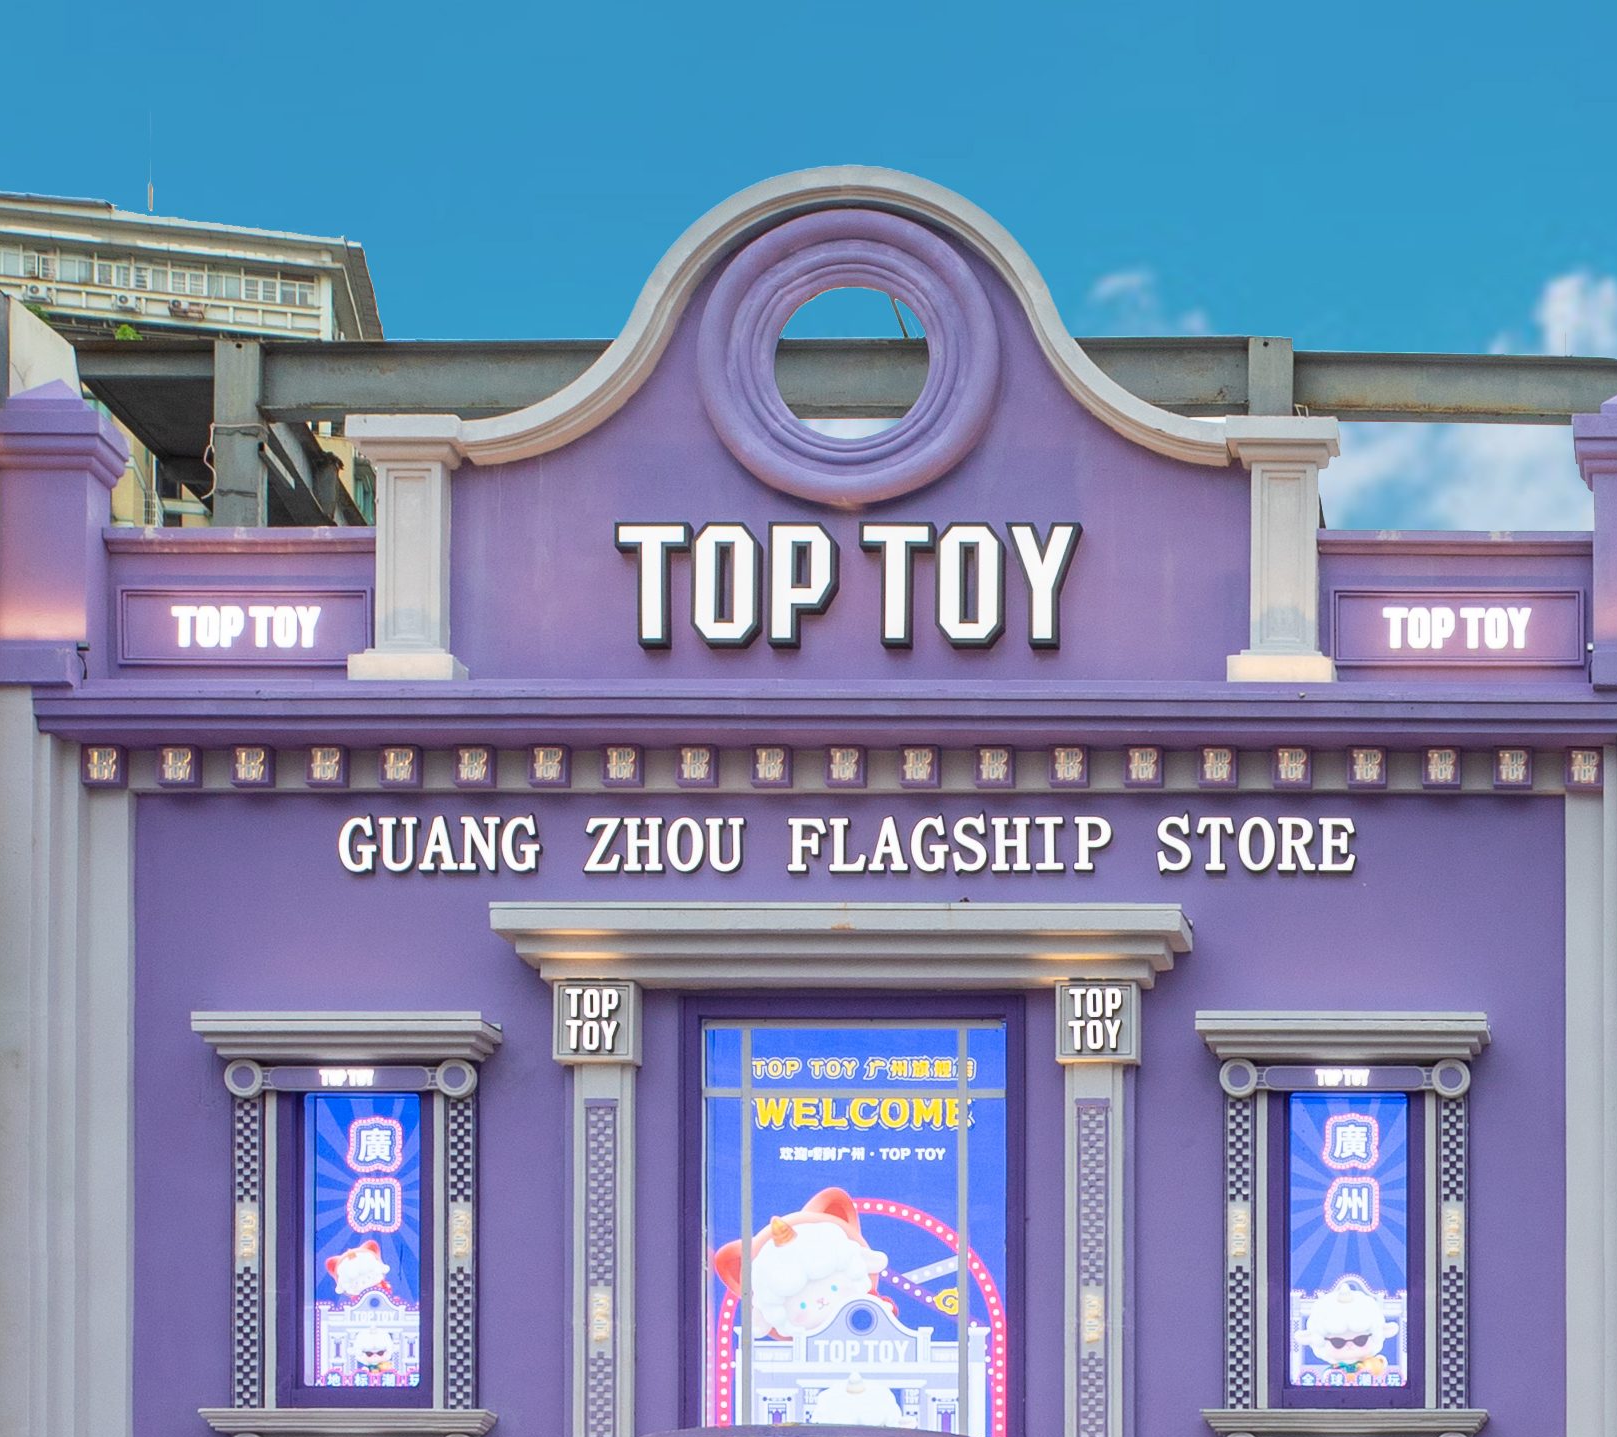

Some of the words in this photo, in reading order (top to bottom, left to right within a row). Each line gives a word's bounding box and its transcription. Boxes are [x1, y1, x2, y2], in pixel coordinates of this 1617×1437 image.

[615, 522, 840, 650] TOP
[859, 521, 1083, 650] TOY
[171, 606, 244, 648] TOP
[248, 606, 321, 648] TOY
[1383, 607, 1456, 649] TOP
[1459, 607, 1532, 649] TOY
[339, 814, 542, 874] GUANG
[583, 816, 746, 874] ZHOU
[787, 814, 1113, 874] FLAGSHIP
[1156, 813, 1357, 874] STORE
[565, 989, 619, 1019] TOP
[1069, 989, 1122, 1020] TOP
[565, 1020, 619, 1053] TOY
[1069, 1020, 1122, 1051] TOY
[752, 1057, 801, 1079] TOP
[809, 1057, 858, 1079] TOY
[754, 1098, 974, 1129] WELCOME
[880, 1148, 911, 1160] TOP
[915, 1148, 945, 1160] TOY
[357, 1126, 393, 1223] 廣州
[1335, 1125, 1369, 1223] 廣州
[814, 1340, 860, 1362] TOP
[863, 1340, 909, 1362] TOY
